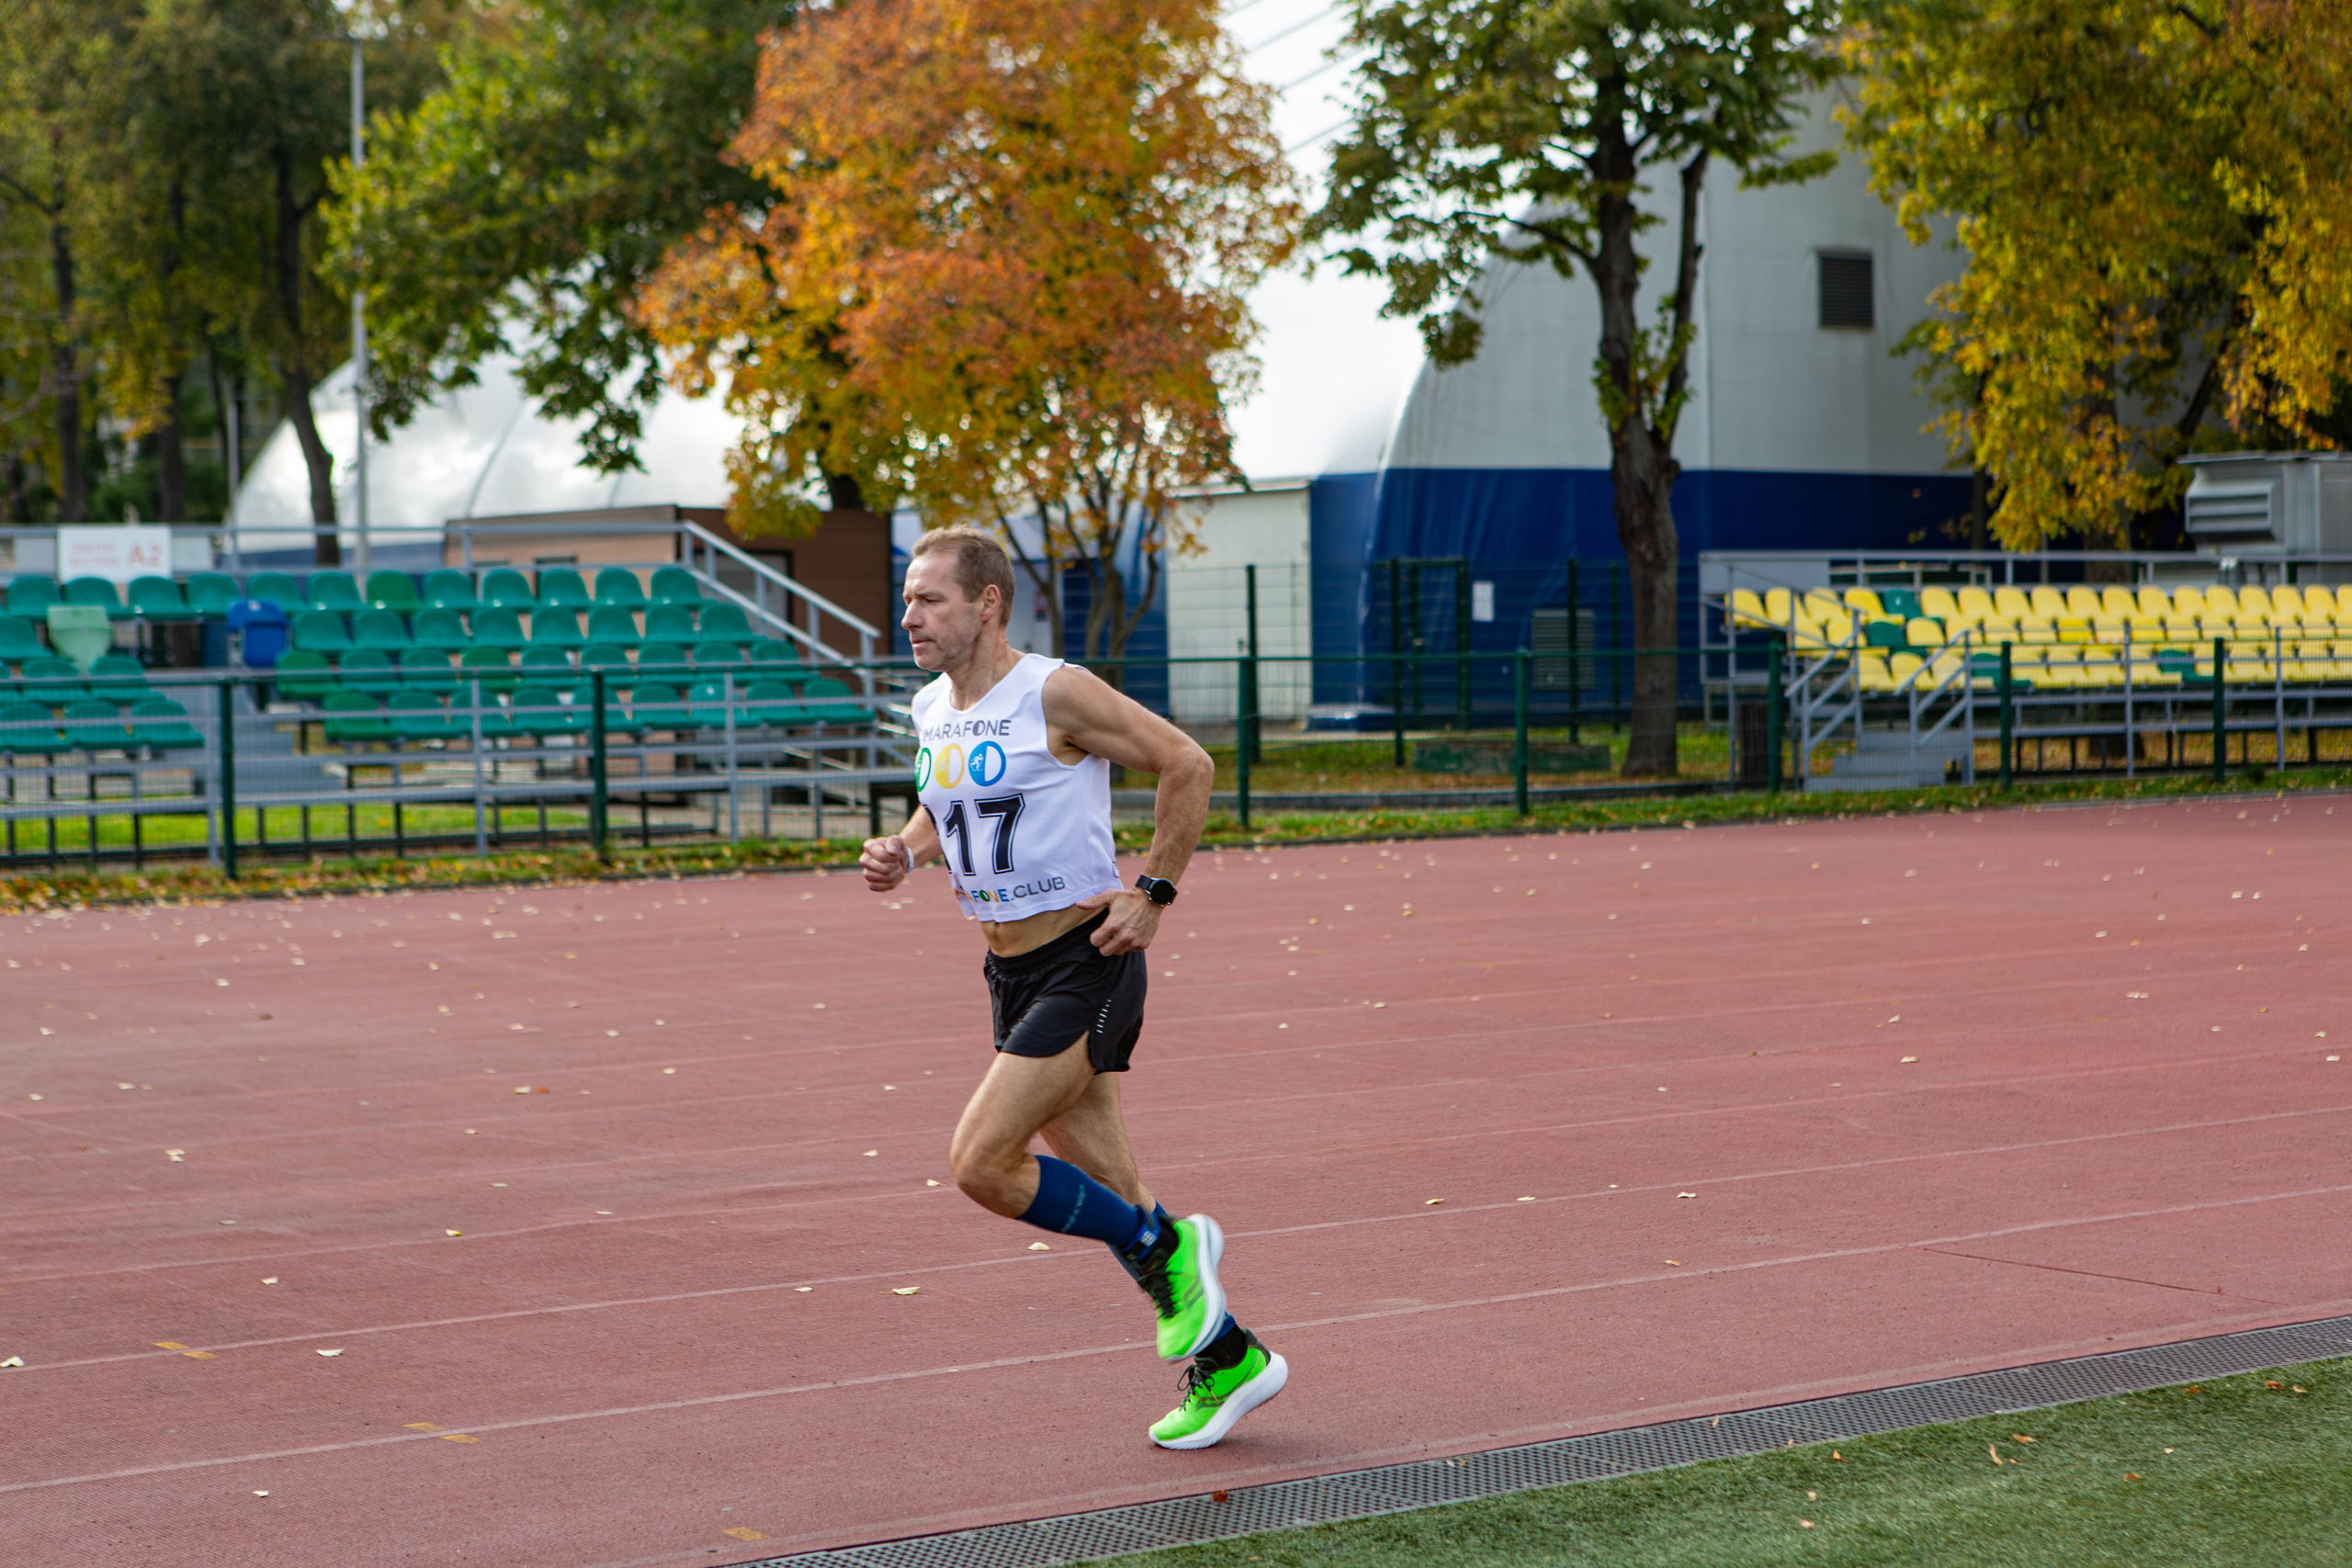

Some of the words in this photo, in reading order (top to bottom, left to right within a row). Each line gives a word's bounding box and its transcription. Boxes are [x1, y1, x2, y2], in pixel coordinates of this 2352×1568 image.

[127, 541, 163, 567] A2
[923, 719, 1012, 741] MARAFONE
[923, 793, 1026, 876] 17
